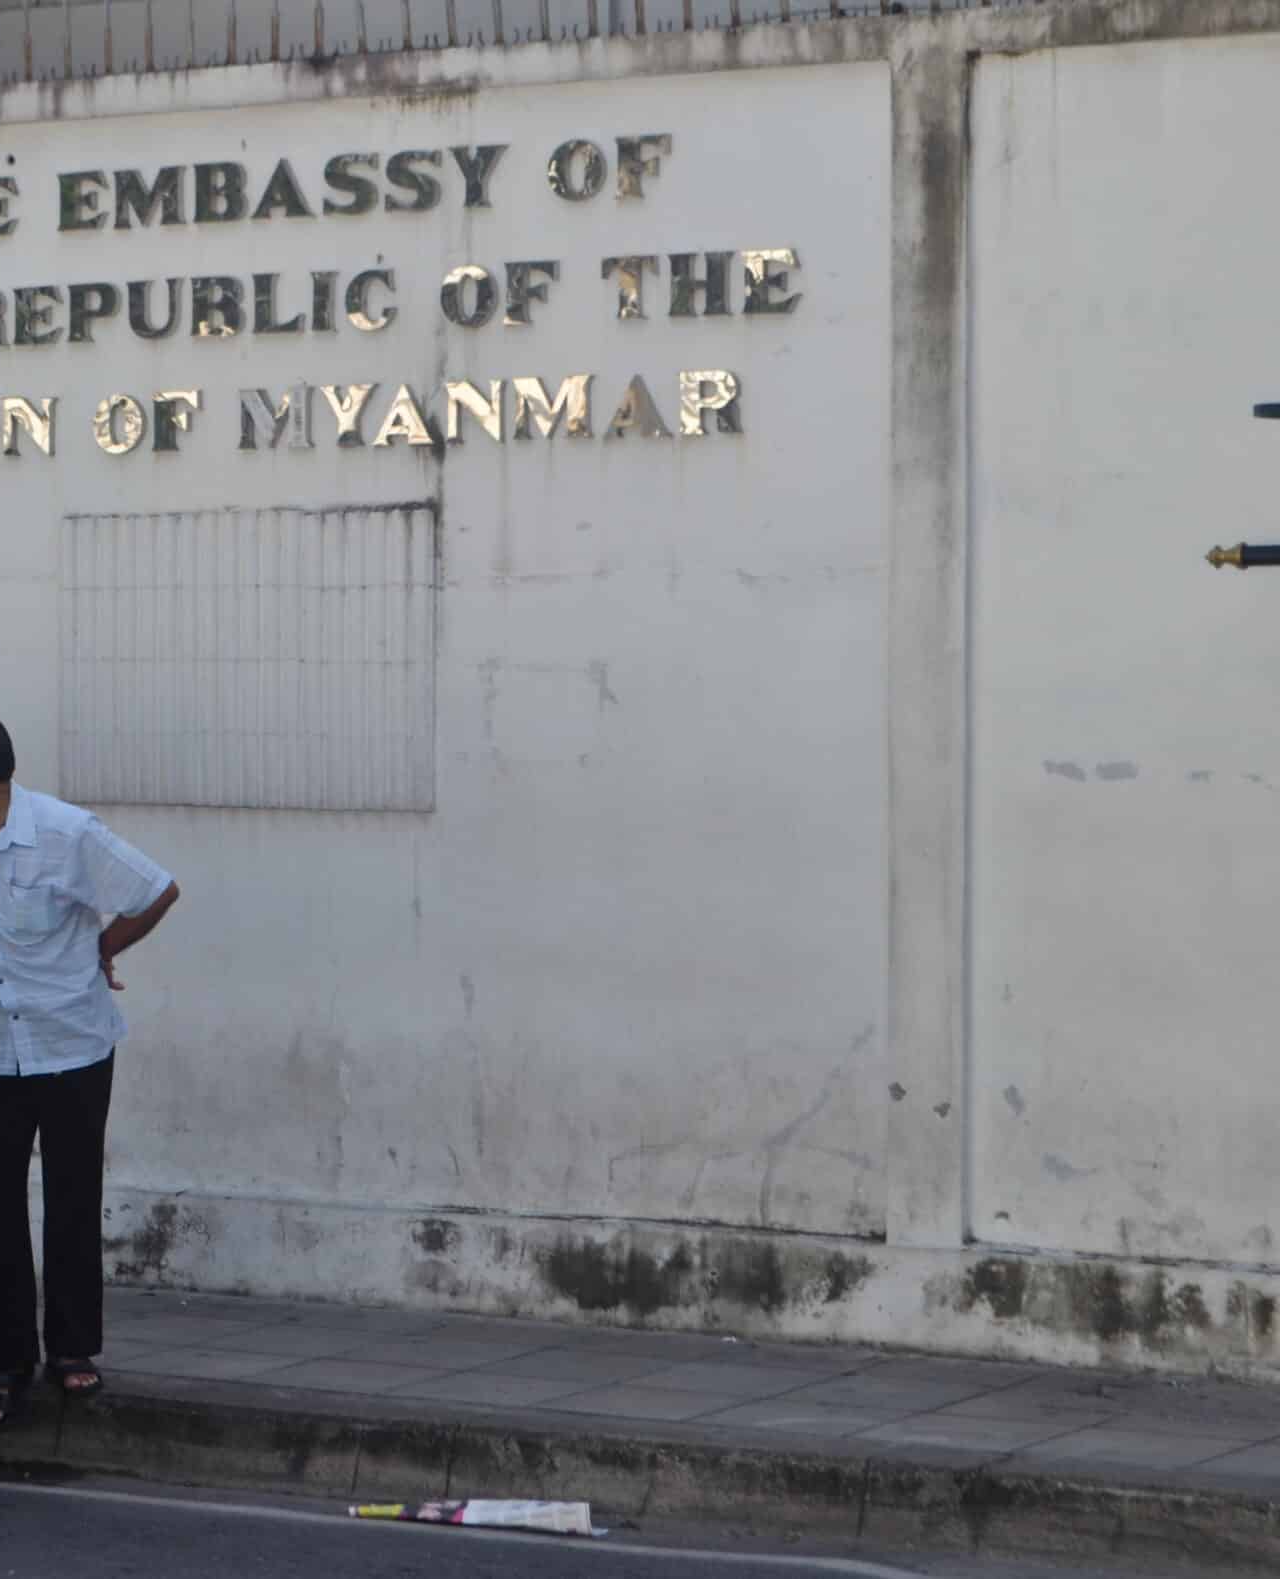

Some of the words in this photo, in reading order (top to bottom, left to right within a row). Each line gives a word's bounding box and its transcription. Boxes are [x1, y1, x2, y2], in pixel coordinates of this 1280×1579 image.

[57, 144, 509, 232] EMBASSY
[547, 133, 672, 201] OF
[440, 260, 560, 330] OF
[601, 248, 803, 320] THE
[93, 390, 202, 455] OF
[237, 368, 744, 450] MYANMAR
